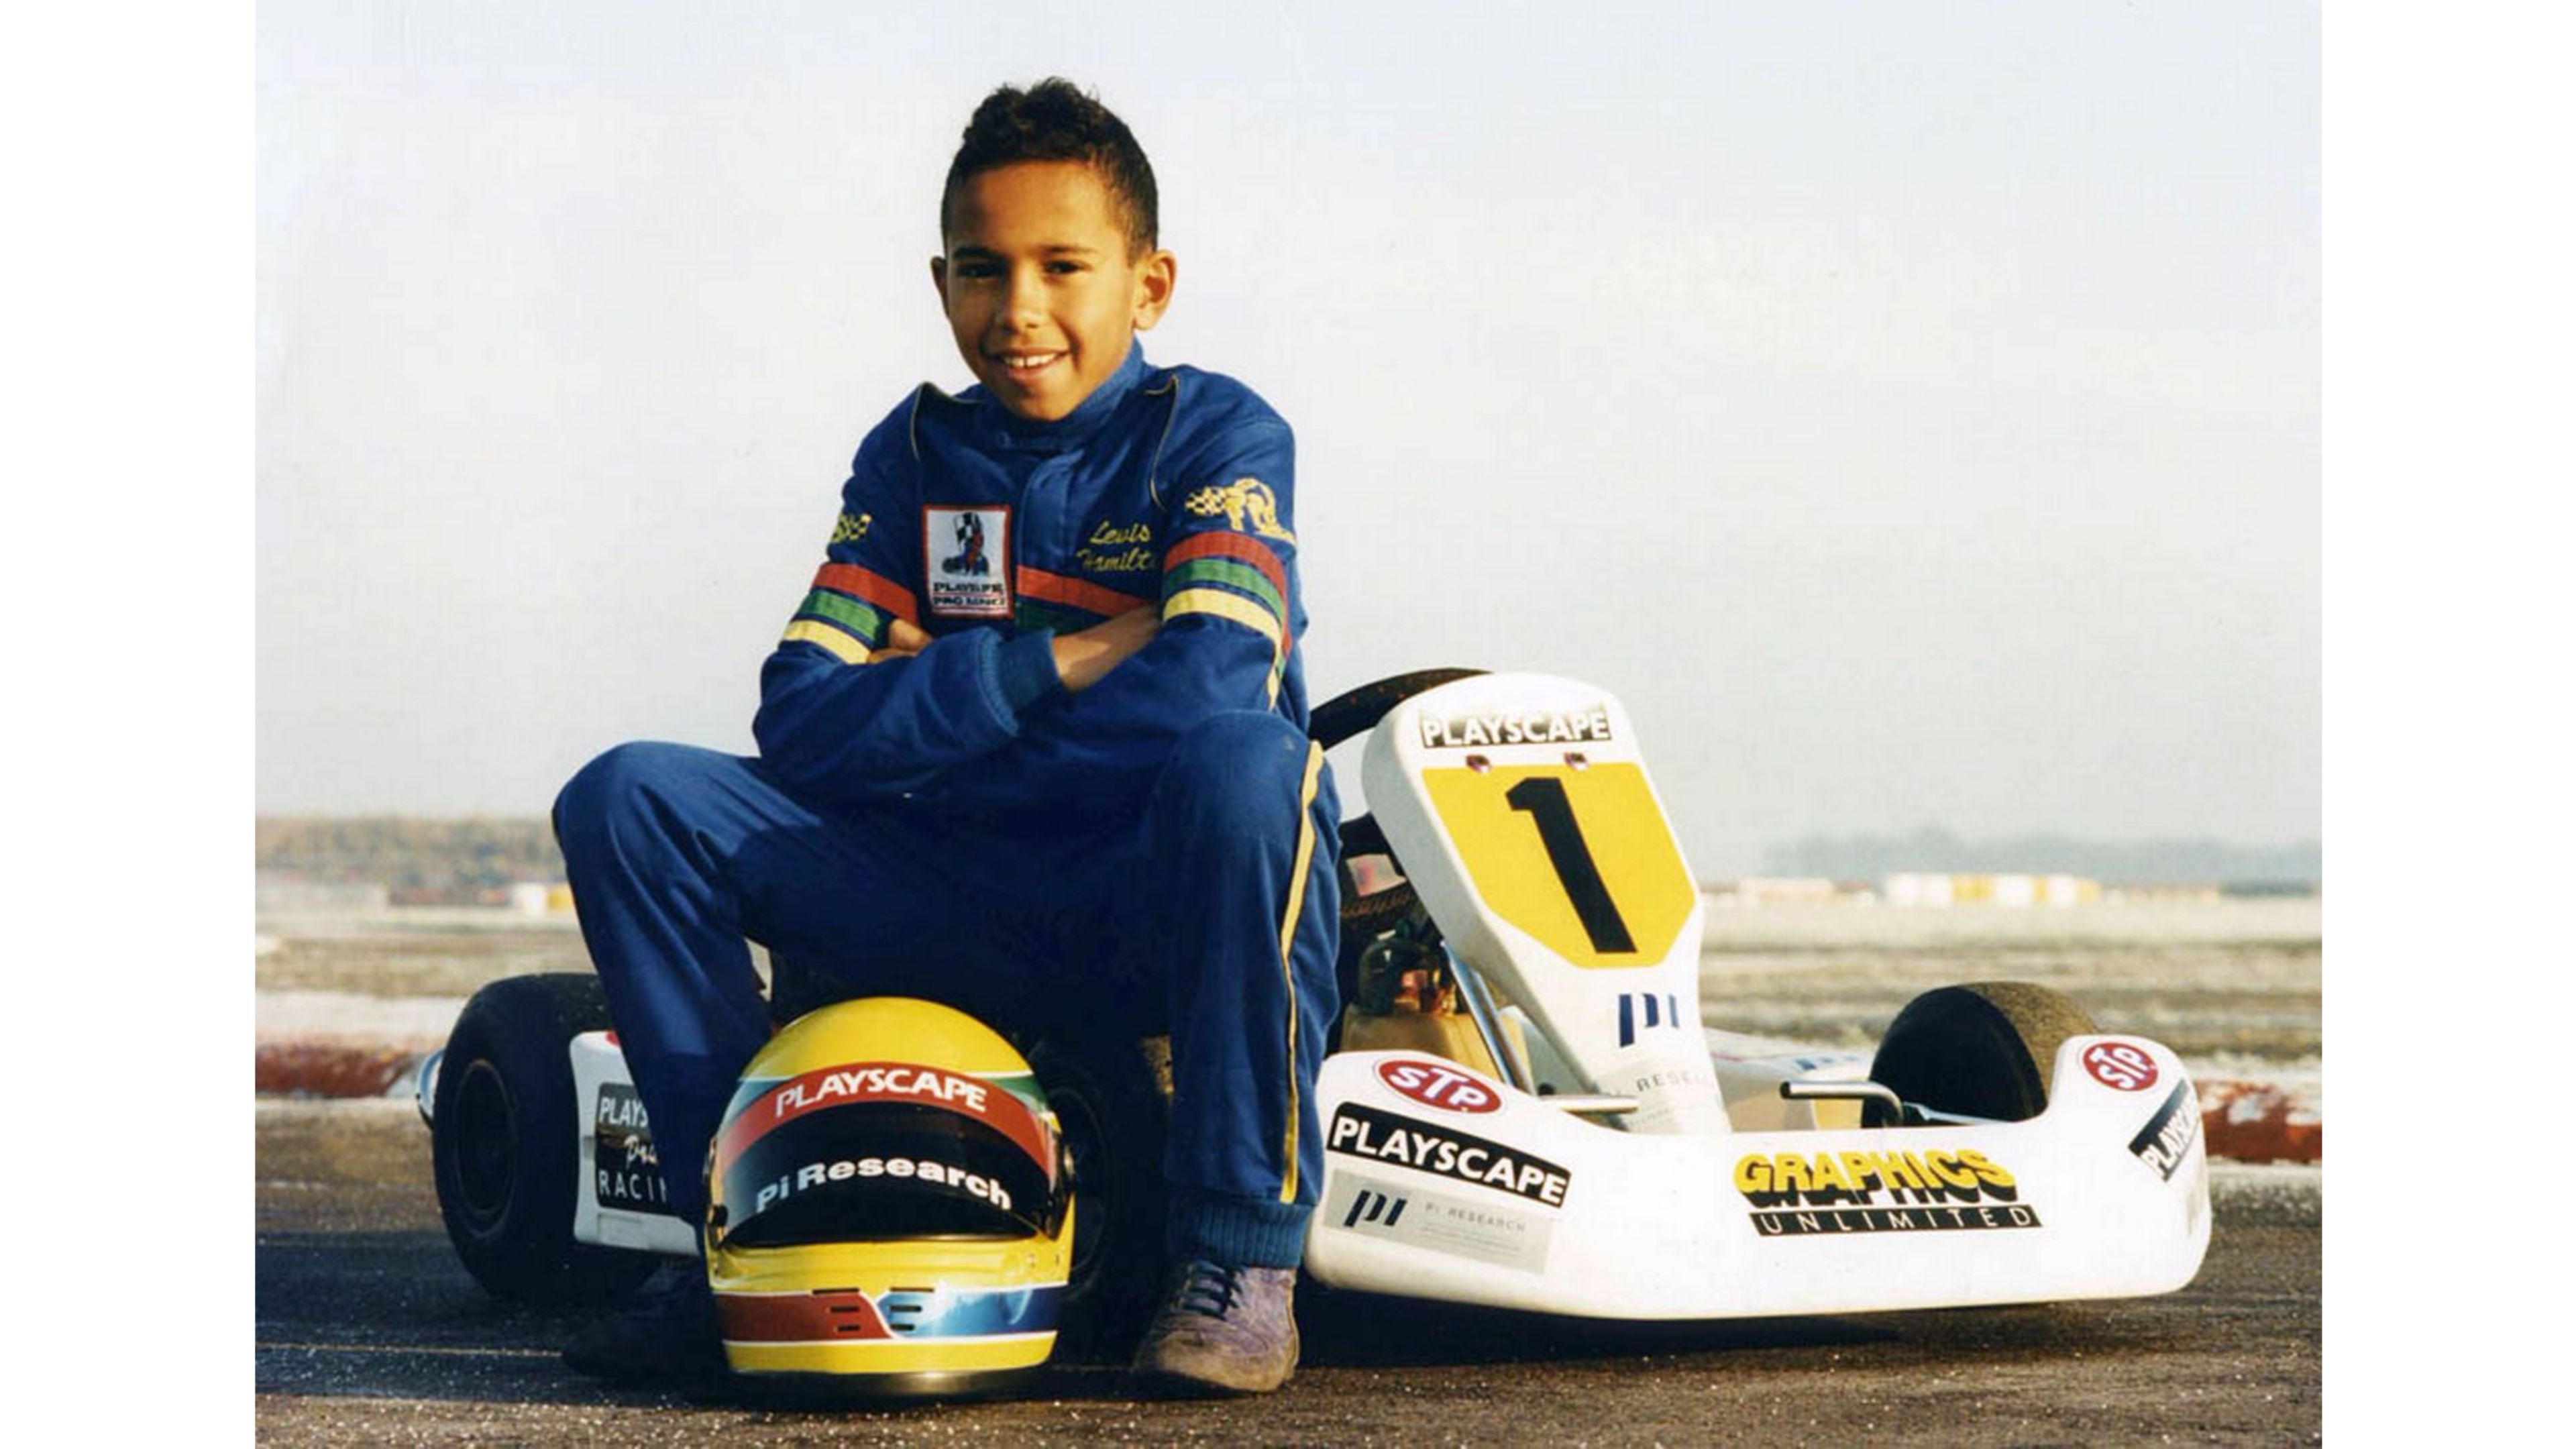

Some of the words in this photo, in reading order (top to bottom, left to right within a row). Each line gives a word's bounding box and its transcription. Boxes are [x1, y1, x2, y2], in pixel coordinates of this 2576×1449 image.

[1076, 547, 1152, 572] Hamilt
[1421, 711, 1610, 747] PLAYSCAPE
[1505, 776, 1639, 953] 1
[1389, 1064, 1489, 1109] STP
[2089, 1046, 2151, 1089] STP
[598, 1097, 649, 1128] PLAYS
[774, 1067, 988, 1118] PLAYSCAPE
[1332, 1116, 1568, 1204] PLAYSCAPE
[1733, 1149, 2017, 1206] GRAPHICS
[598, 1170, 667, 1203] RACI
[756, 1175, 789, 1212] Pi
[797, 1157, 1012, 1210] Research
[1448, 1207, 1526, 1233] RESEARCH
[1760, 1208, 2031, 1234] UNLIMITED
